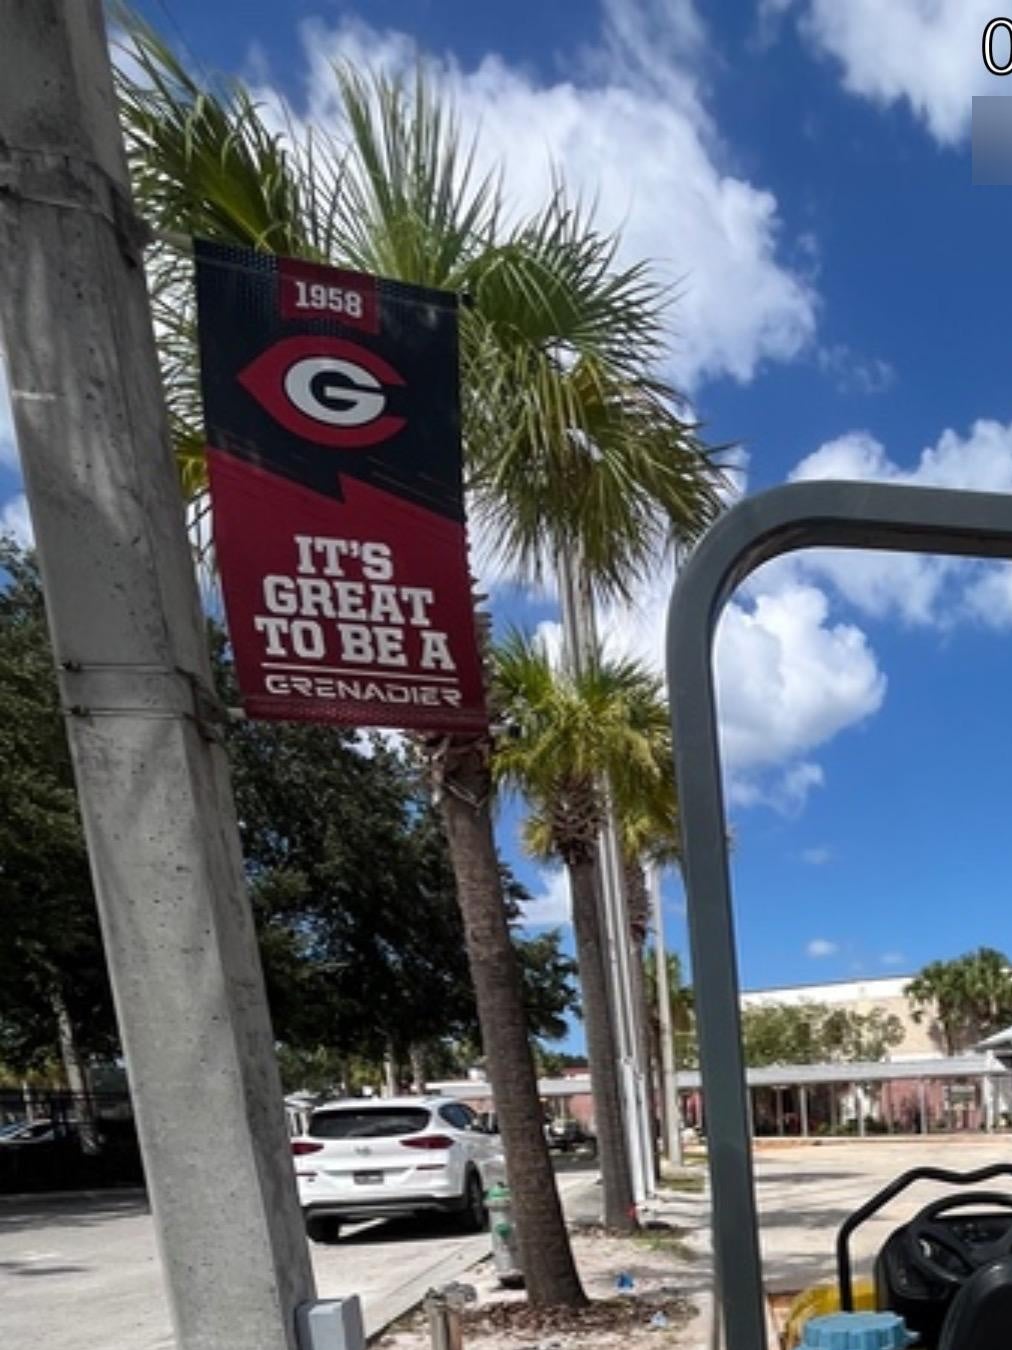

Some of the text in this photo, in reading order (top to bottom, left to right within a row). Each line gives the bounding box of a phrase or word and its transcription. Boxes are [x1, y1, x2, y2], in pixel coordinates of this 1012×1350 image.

[296, 281, 362, 319] 1958
[283, 356, 387, 426] G
[294, 534, 393, 580] IT'S
[263, 575, 434, 627] GREAT
[254, 615, 456, 671] TO BE A
[265, 675, 462, 707] GRENADIER
